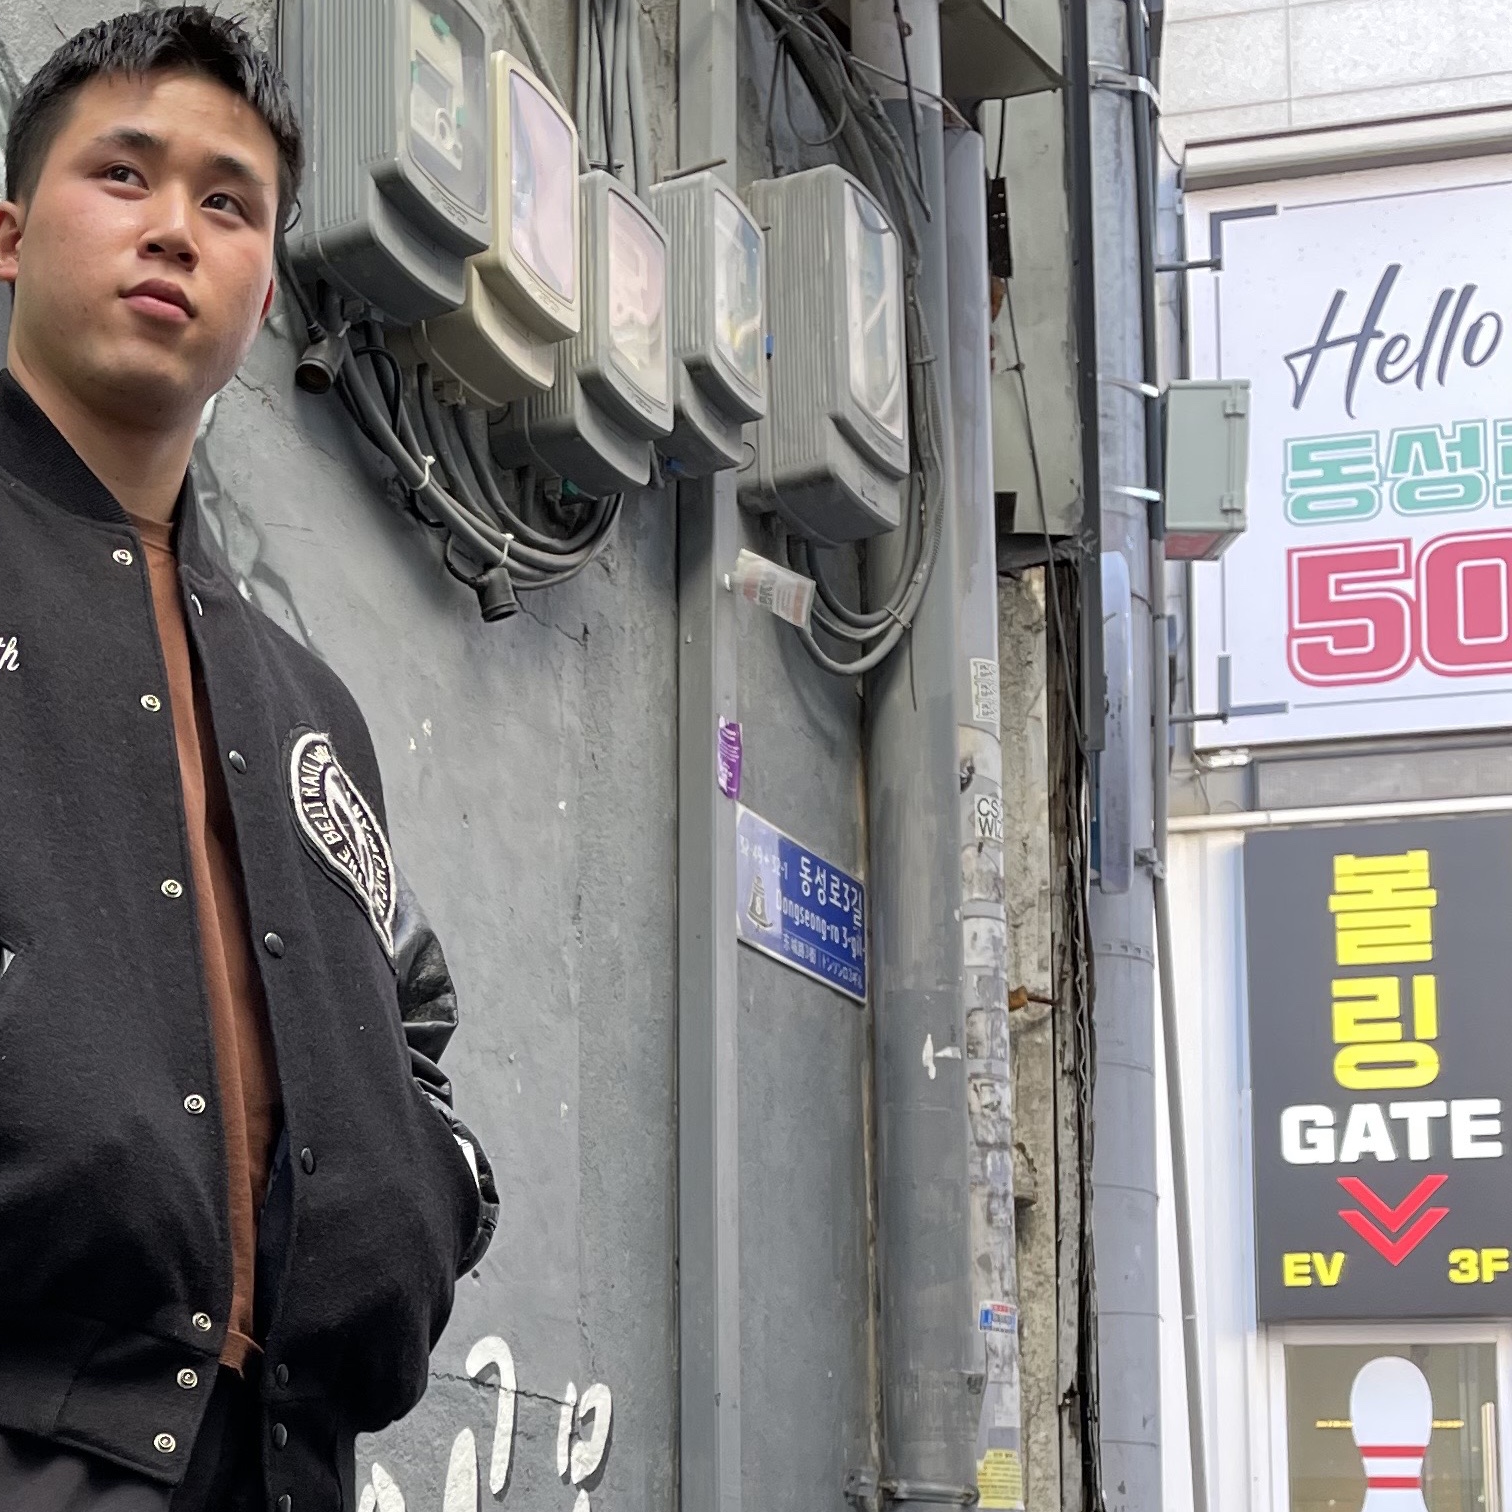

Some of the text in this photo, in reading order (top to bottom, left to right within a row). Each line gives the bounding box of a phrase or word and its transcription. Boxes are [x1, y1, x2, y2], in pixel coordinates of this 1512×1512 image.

[1283, 263, 1503, 419] Hello
[1283, 418, 1512, 527] 동성
[1286, 527, 1512, 688] 50
[302, 799, 344, 846] BELT
[775, 888, 840, 944] Dongseong-ro
[798, 855, 864, 928] 동성로3길
[1328, 849, 1440, 1090] 볼링
[1280, 1098, 1505, 1164] GATE
[1282, 1247, 1511, 1288] EV 3F
